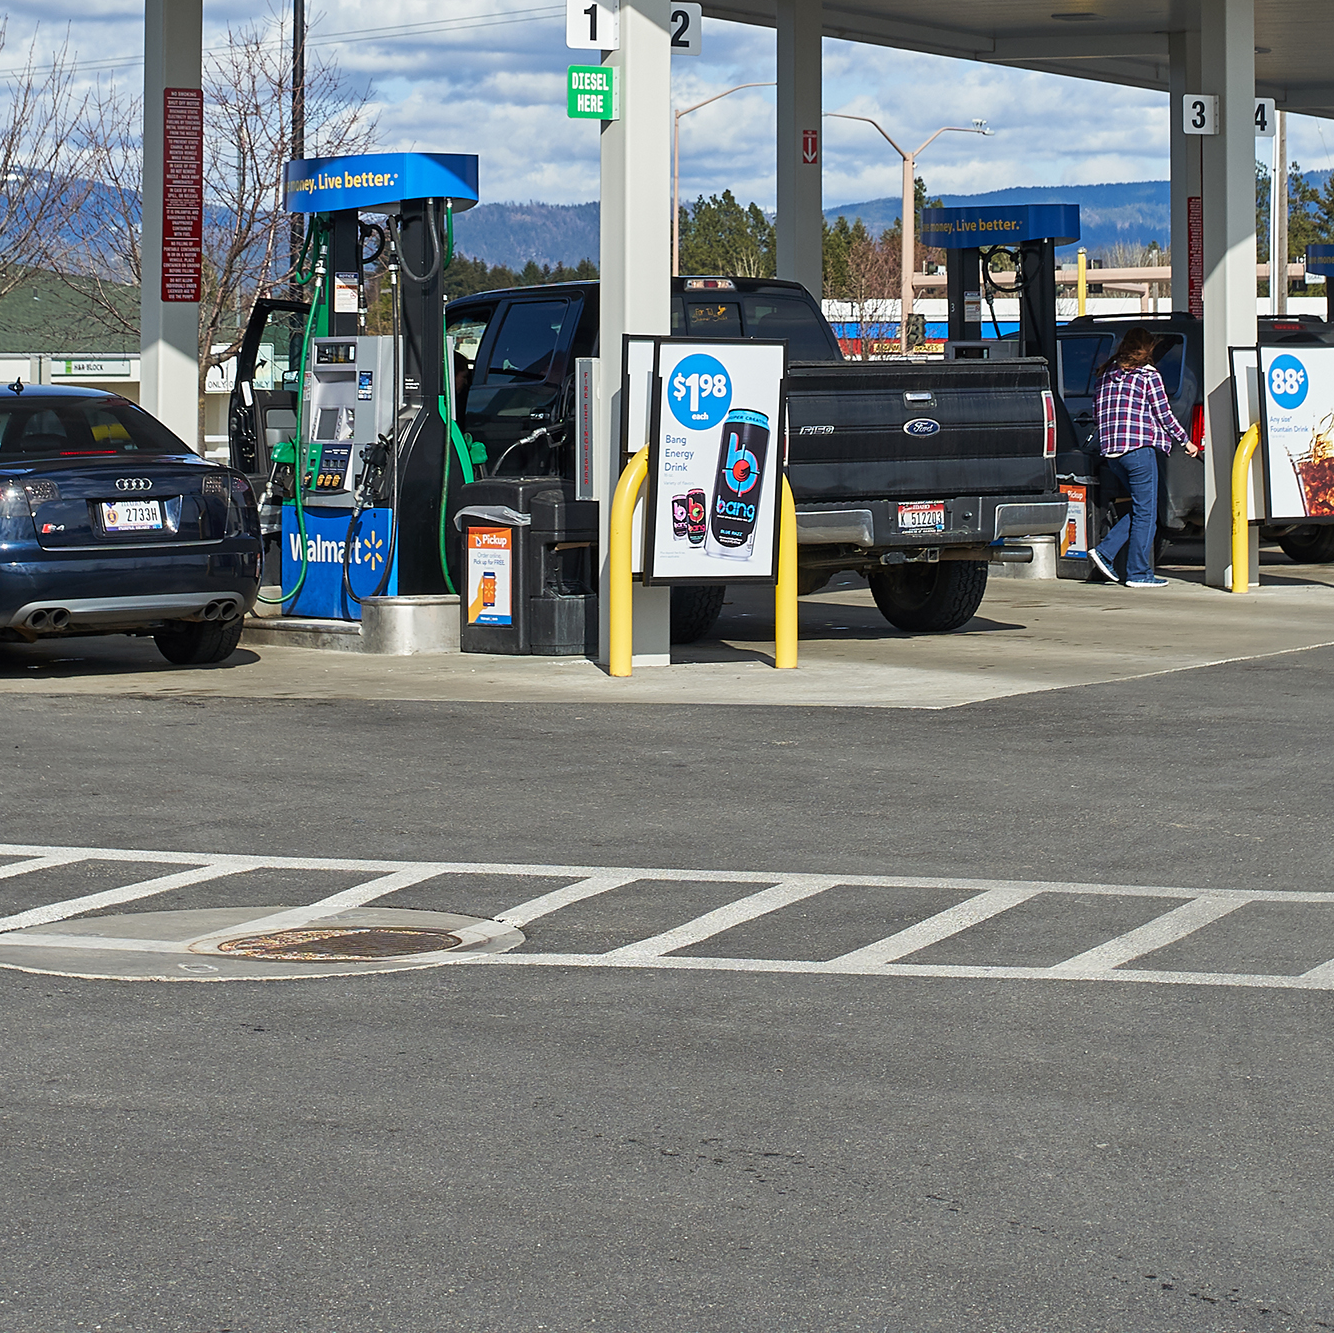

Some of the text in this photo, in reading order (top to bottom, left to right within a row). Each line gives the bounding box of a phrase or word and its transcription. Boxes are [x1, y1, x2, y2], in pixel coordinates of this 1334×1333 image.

[584, 4, 597, 41] 1
[670, 9, 690, 48] 2
[572, 72, 609, 91] DIESEL
[577, 94, 604, 113] HERE
[1192, 100, 1206, 129] 3
[1255, 103, 1267, 132] 4
[318, 173, 342, 190] Live
[344, 171, 395, 188] better.
[930, 218, 1020, 235] money. Live better.
[74, 363, 104, 371] H&R BLOCK
[1271, 368, 1305, 395] 88¢
[691, 412, 709, 420] each
[1270, 416, 1280, 424] Any
[913, 421, 934, 433] Ford
[665, 434, 687, 446] Bang
[665, 448, 695, 460] Energy
[664, 462, 688, 471] Drink
[126, 507, 158, 522] 2733H
[715, 495, 756, 523] bang
[901, 511, 943, 526] K 512203
[482, 534, 507, 547] Pickup
